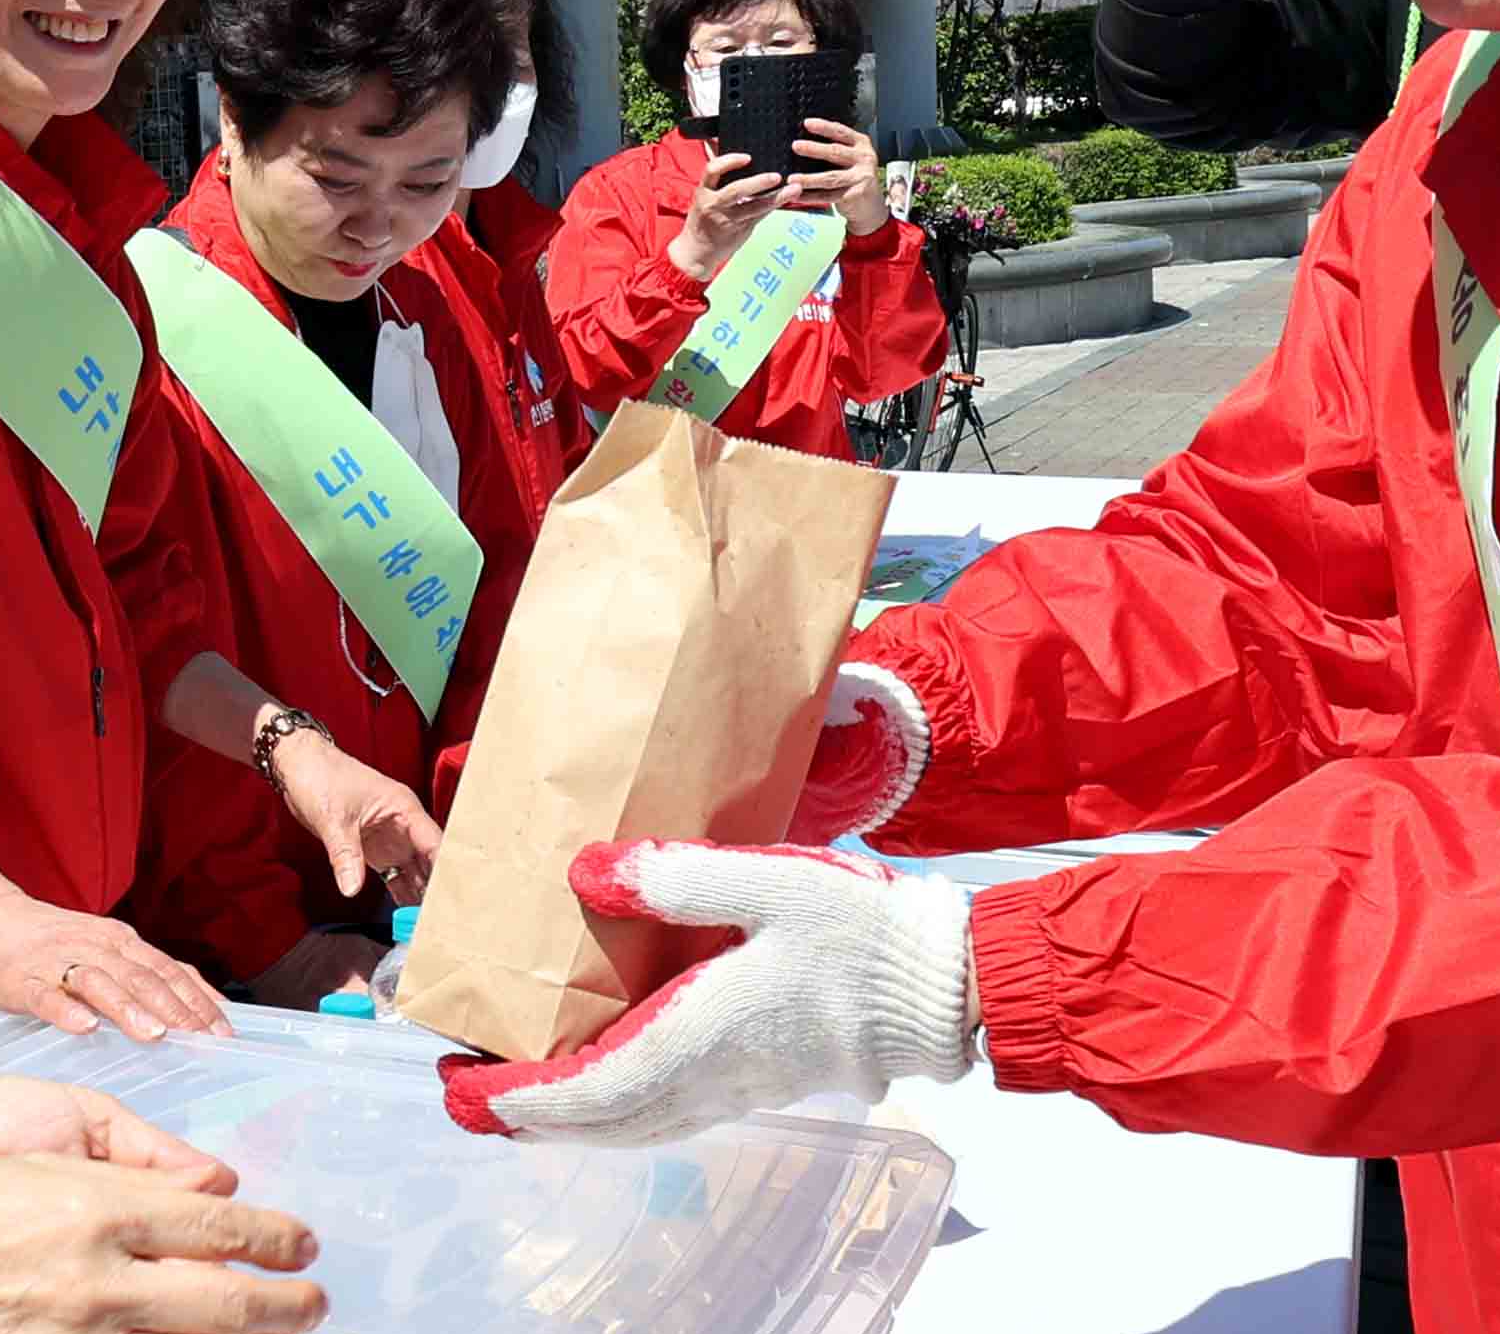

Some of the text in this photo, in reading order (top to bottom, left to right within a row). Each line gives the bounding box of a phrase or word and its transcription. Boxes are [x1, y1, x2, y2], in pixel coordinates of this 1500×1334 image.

[738, 244, 796, 324] 쓰레기
[688, 320, 741, 376] 하나
[57, 355, 120, 434] 내가
[313, 447, 391, 530] 내가
[377, 538, 451, 619] 주운
